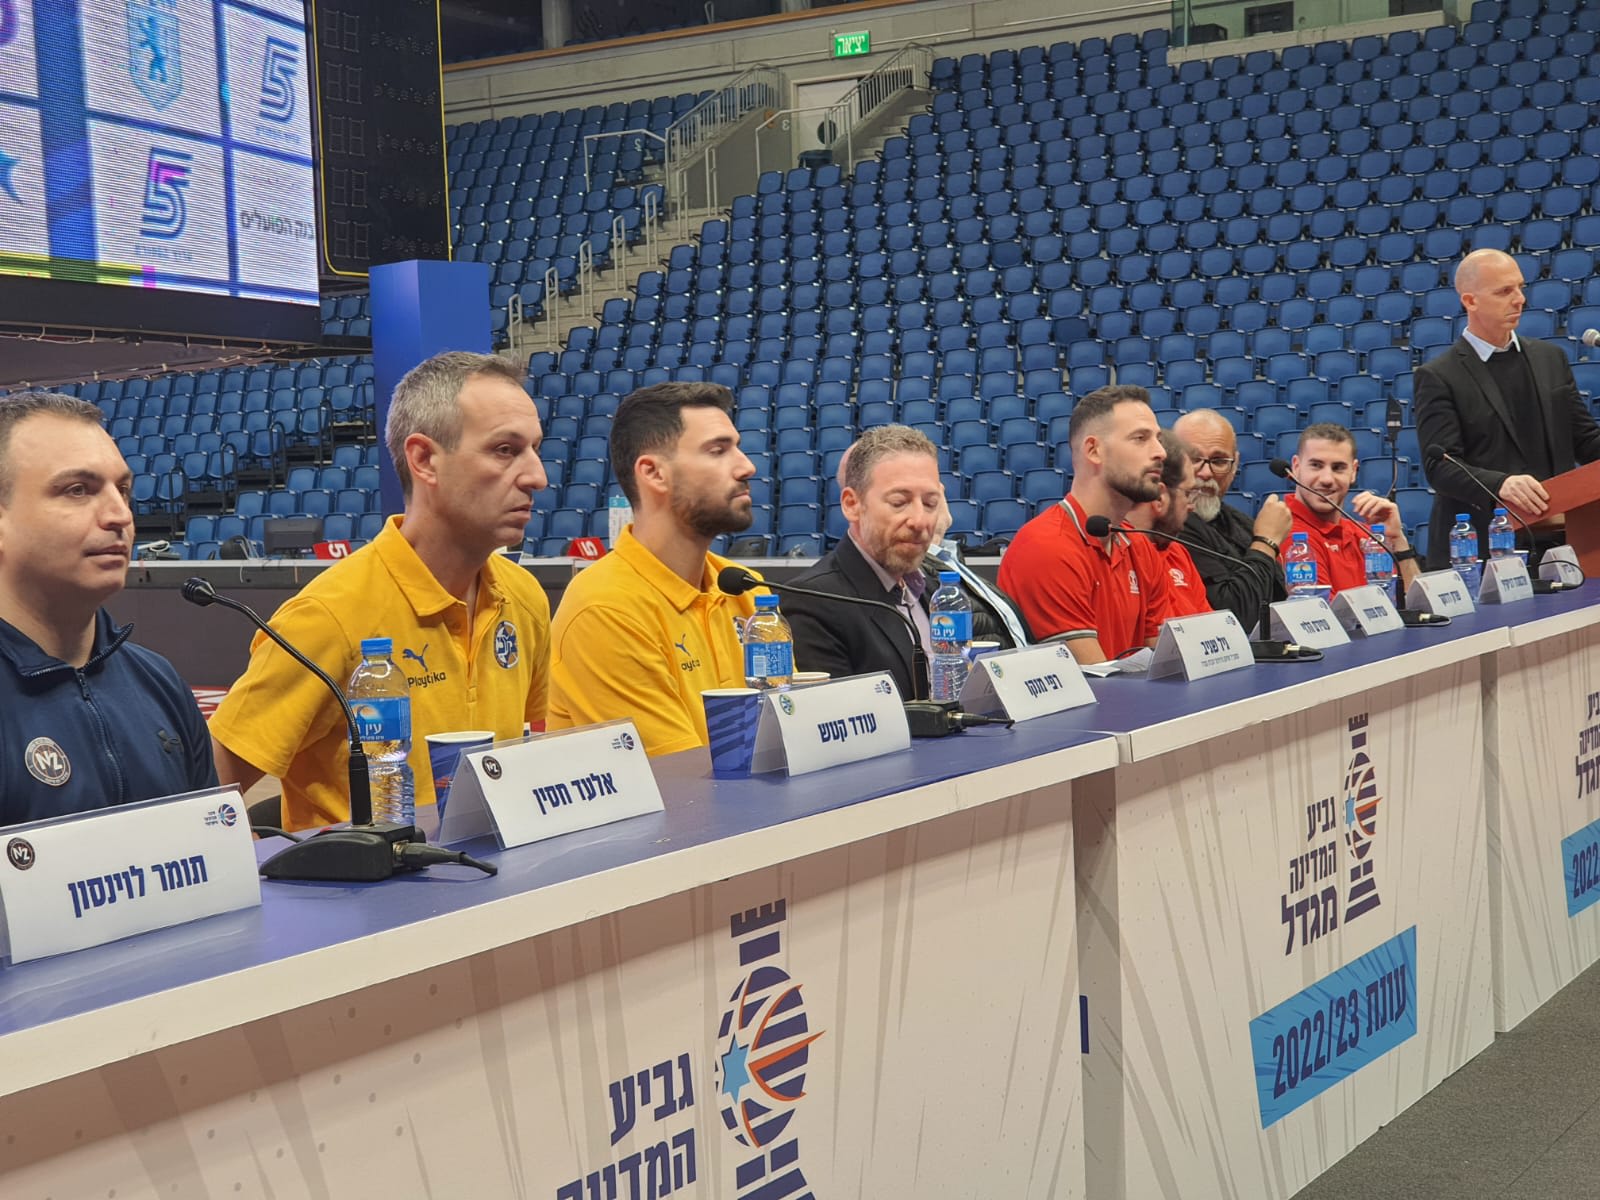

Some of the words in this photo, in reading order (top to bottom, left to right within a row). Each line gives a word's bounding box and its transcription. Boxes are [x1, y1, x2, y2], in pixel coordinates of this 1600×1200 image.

[837, 35, 866, 56] יציאה
[407, 671, 447, 688] Playtika
[1024, 678, 1048, 699] מנקו
[1047, 673, 1064, 693] רפי
[817, 720, 848, 744] קטש
[847, 712, 878, 736] עודד
[532, 782, 573, 816] חסין
[571, 772, 618, 802] אלעד
[1306, 796, 1336, 842] גביע
[151, 854, 209, 892] תומר
[1289, 840, 1337, 895] המדינה
[67, 865, 146, 919] לוינסון
[1281, 885, 1338, 955] מגדל
[1366, 963, 1408, 1039] עונת
[1272, 987, 1361, 1100] 2022/23
[609, 1052, 694, 1147] גביע
